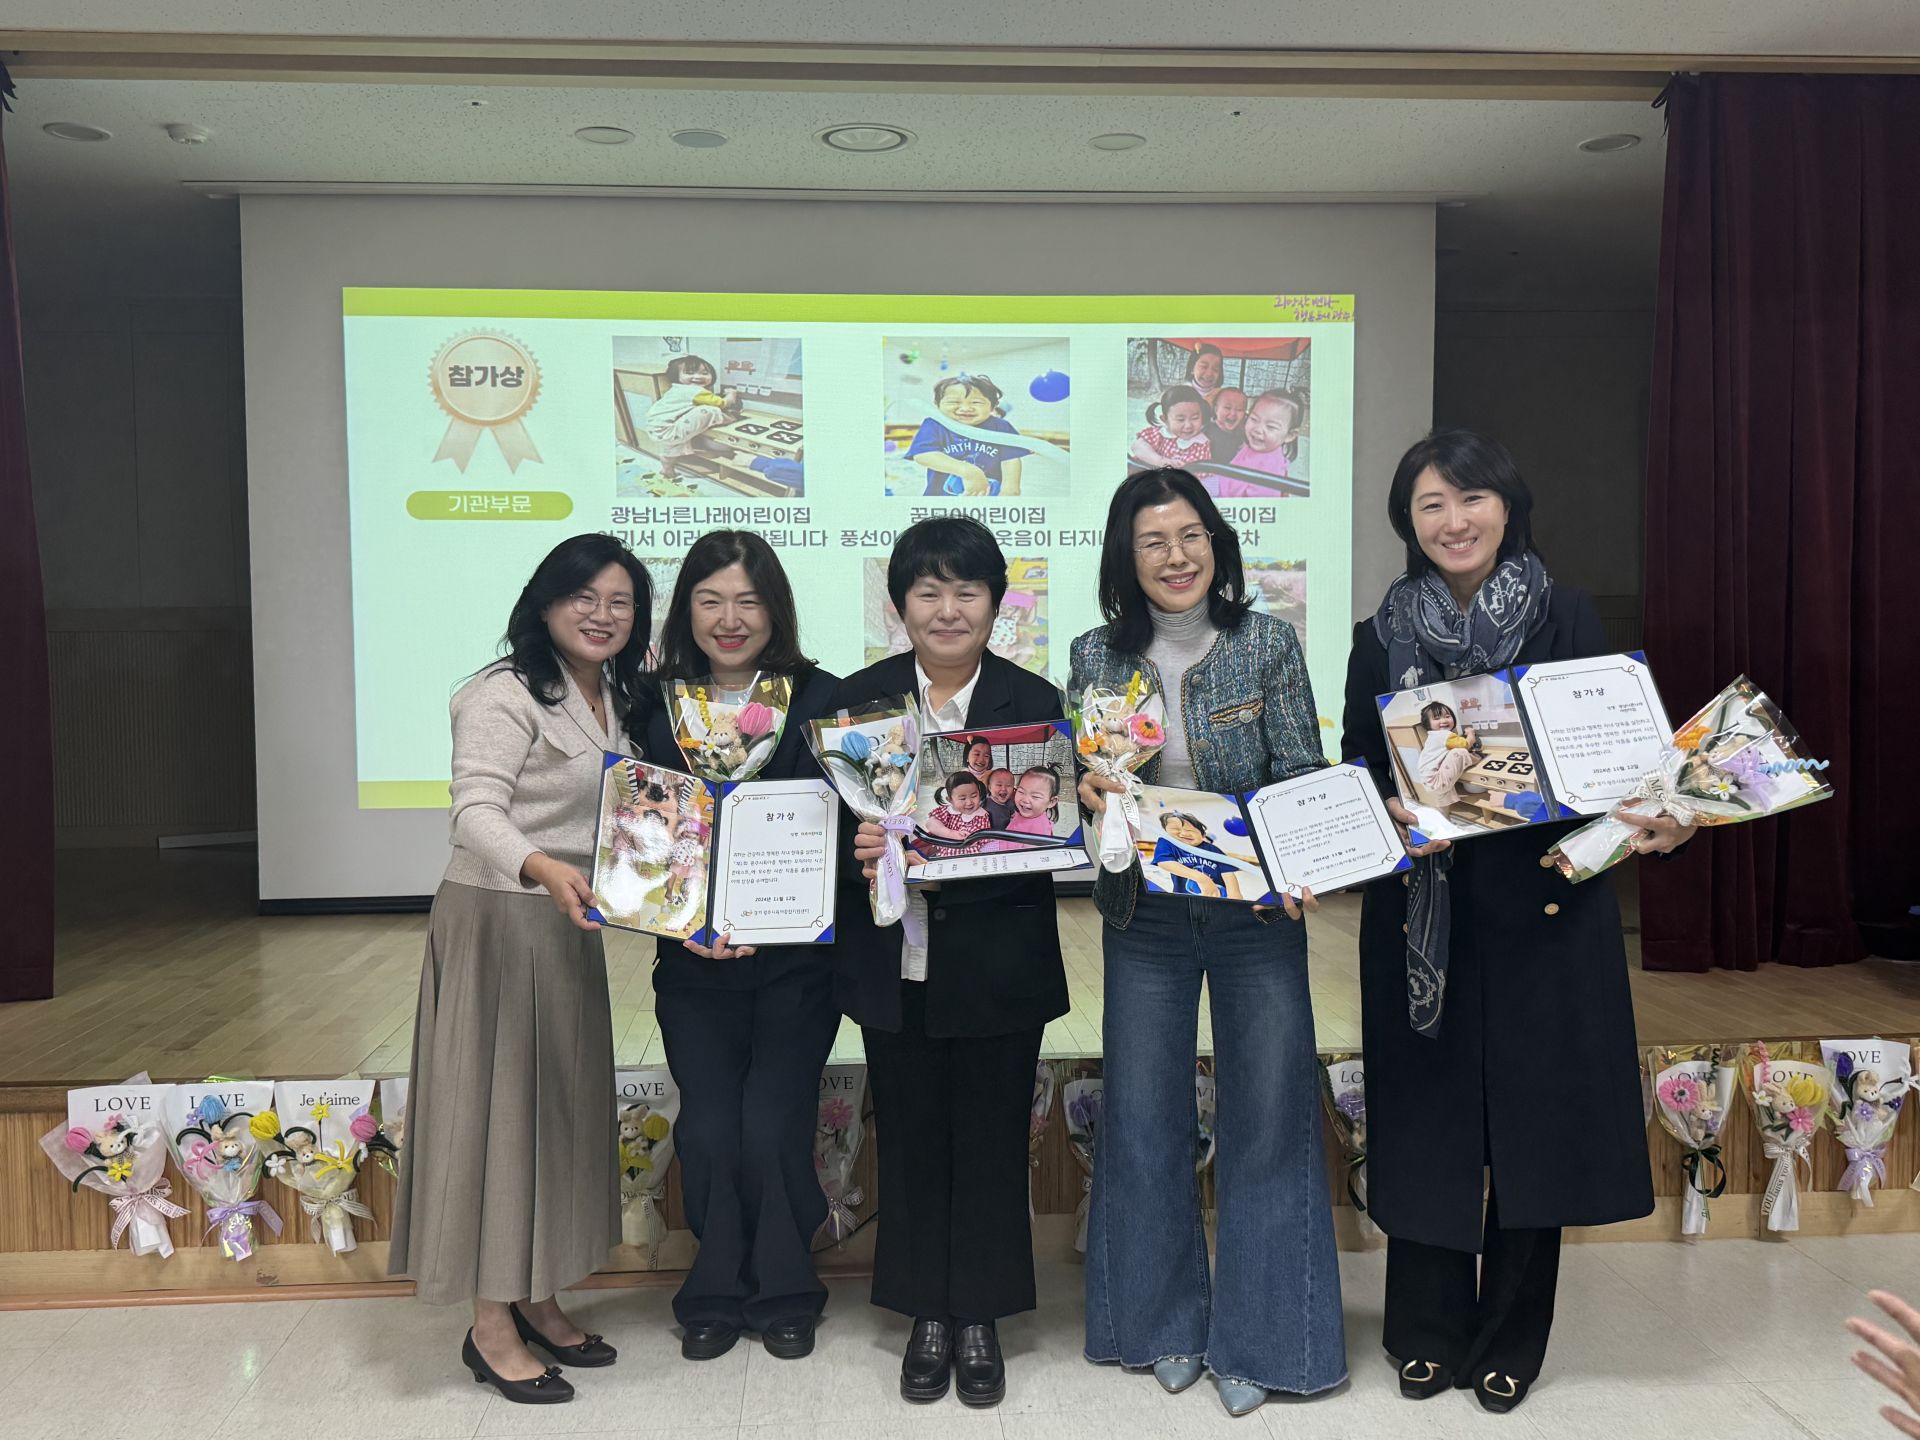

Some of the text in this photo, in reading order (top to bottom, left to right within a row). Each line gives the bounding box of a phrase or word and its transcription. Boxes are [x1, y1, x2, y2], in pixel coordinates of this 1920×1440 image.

[448, 364, 525, 388] 참가상
[448, 495, 531, 513] 기관부문
[610, 506, 811, 524] 광남너른나래어린이집
[1219, 507, 1276, 524] 린이집
[598, 530, 655, 547] 기서
[995, 530, 1051, 547] 웃음이
[1238, 530, 1260, 546] 차
[1848, 1050, 1880, 1063] OVE
[819, 1076, 854, 1090] OVE
[1341, 1070, 1364, 1083] LO
[95, 1096, 151, 1112] LOVE
[190, 1093, 246, 1110] LVE
[300, 1093, 360, 1107] Je t'aime
